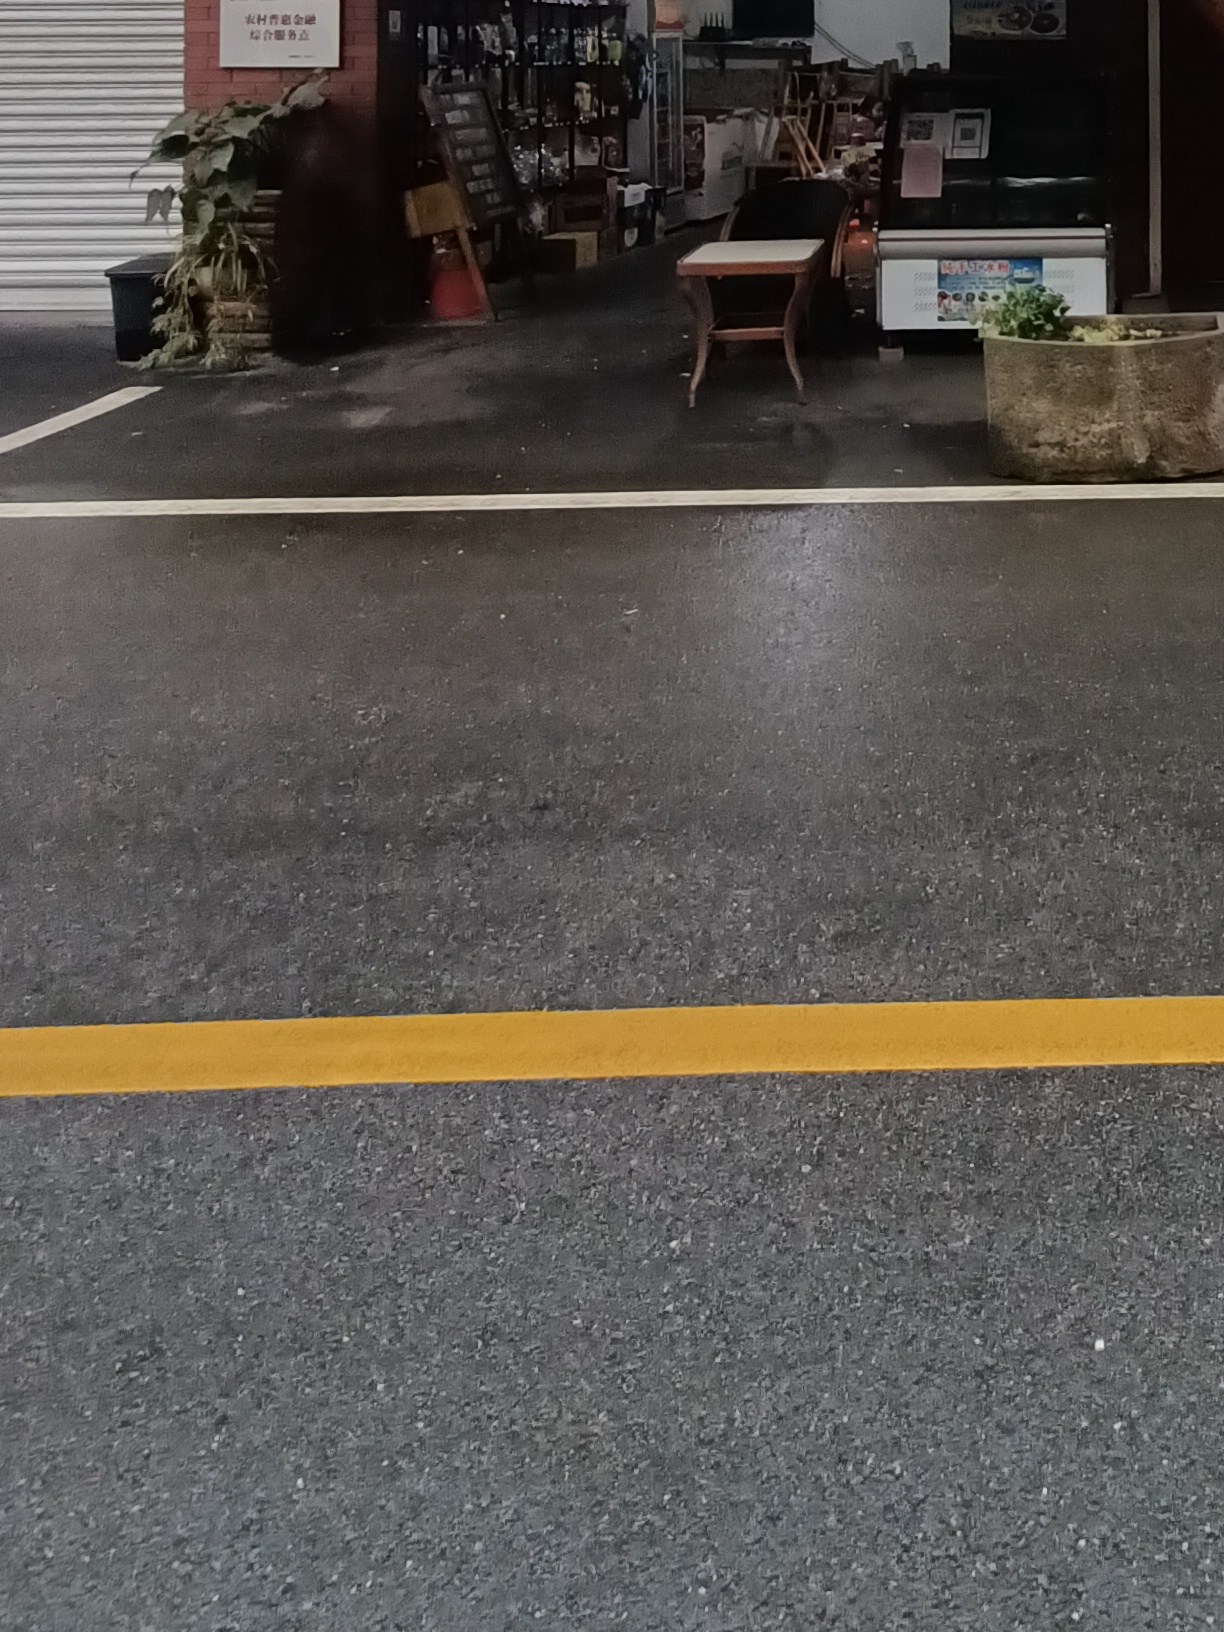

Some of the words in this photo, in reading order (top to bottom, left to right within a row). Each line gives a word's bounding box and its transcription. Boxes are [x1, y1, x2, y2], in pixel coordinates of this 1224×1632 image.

[249, 29, 311, 42] 综合服务点
